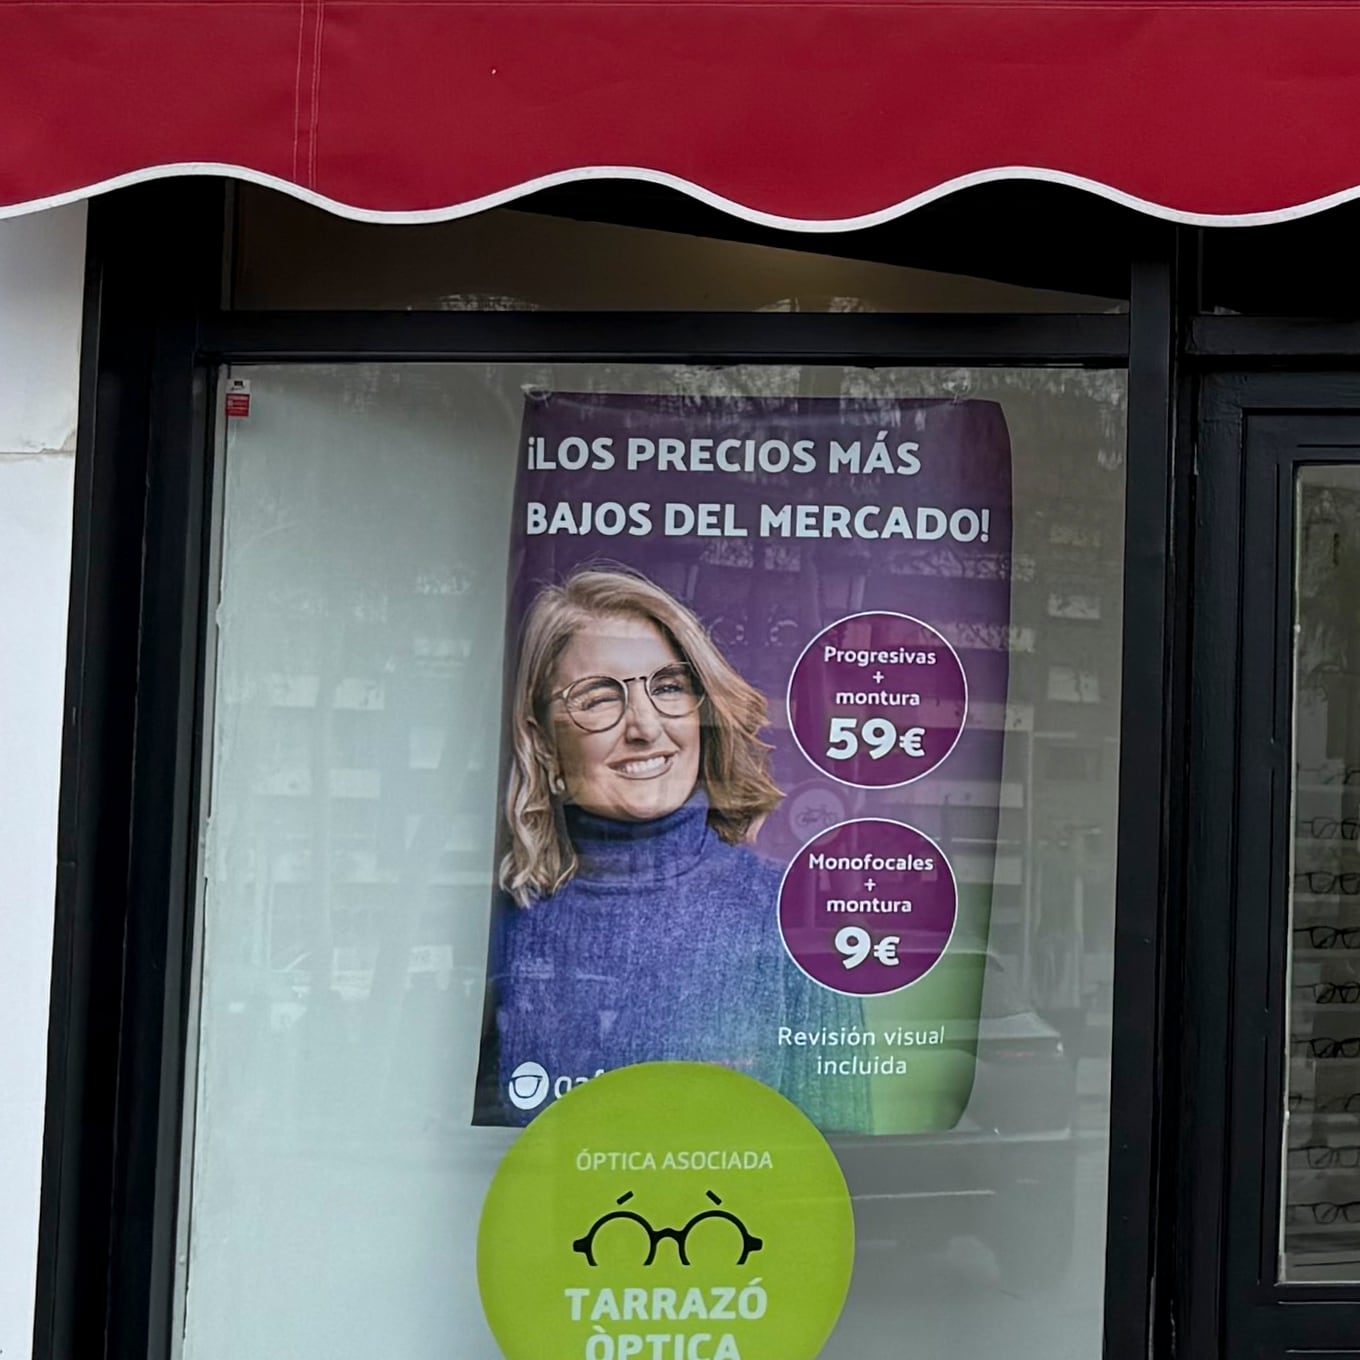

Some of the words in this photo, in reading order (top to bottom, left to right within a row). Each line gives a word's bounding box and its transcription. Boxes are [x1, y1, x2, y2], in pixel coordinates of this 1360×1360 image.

[527, 437, 615, 471] ¡LOS
[628, 438, 816, 474] PRECIOS
[828, 430, 921, 476] MÁS
[526, 501, 653, 536] BAJOS
[664, 503, 748, 537] DEL
[760, 504, 990, 542] MERCADO!
[824, 646, 937, 667] Progresivas
[836, 690, 920, 706] montura
[826, 718, 926, 761] 59€
[809, 853, 934, 871] Monofocales
[827, 898, 912, 913] montura
[834, 926, 900, 970] 9€
[778, 1026, 876, 1046] Revisión
[883, 1025, 945, 1045] visual
[816, 1055, 907, 1076] incluida
[576, 1147, 657, 1171] ÓPTICA
[661, 1150, 773, 1171] ASOCIADA
[564, 1277, 768, 1322] TARRAZÓ
